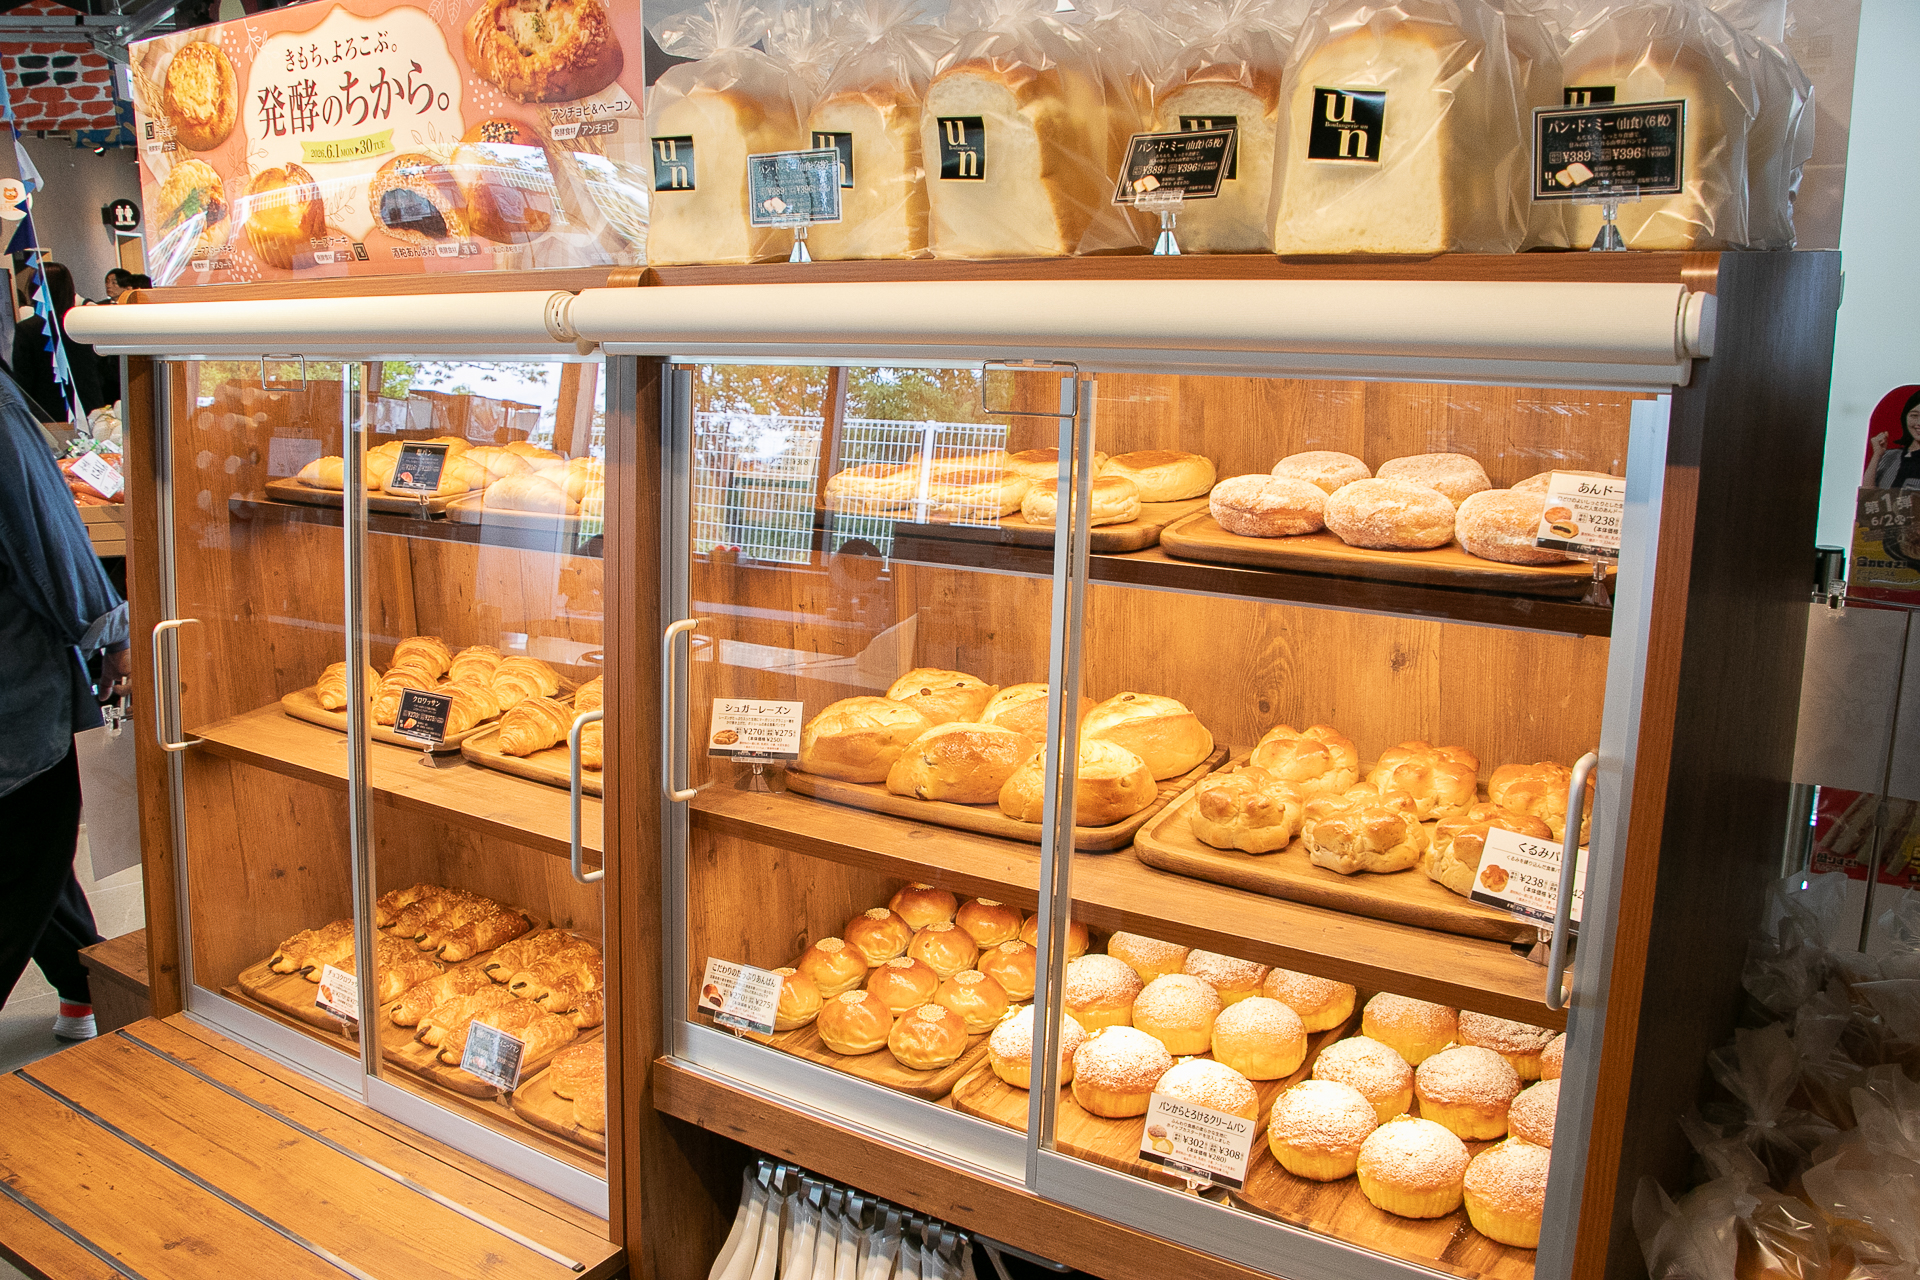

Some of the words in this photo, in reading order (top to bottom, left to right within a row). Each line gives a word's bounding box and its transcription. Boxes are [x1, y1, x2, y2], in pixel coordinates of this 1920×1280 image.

[285, 31, 398, 72] きもち、よろこぶ。
[257, 59, 450, 140] 発酵のちから。
[1323, 93, 1355, 122] u
[582, 122, 614, 135] アンチョビ
[943, 120, 968, 145] u
[1325, 121, 1359, 129] Boulangerie
[657, 140, 679, 162] u
[1338, 129, 1369, 158] n
[957, 150, 978, 176] n
[1562, 150, 1591, 163] ¥389
[1612, 147, 1642, 160] ¥396
[670, 165, 690, 188] n
[1143, 165, 1163, 175] ¥389
[1177, 162, 1198, 173] ¥396
[1589, 514, 1615, 526] ¥238
[412, 695, 441, 707] クロワッサン
[725, 703, 791, 715] シュガーレーズン
[743, 727, 762, 736] ¥270
[774, 729, 793, 737] ¥275
[1518, 842, 1562, 862] くるみパ
[1520, 873, 1544, 888] ¥238
[729, 990, 746, 1002] ¥270
[755, 998, 771, 1009] ¥275
[1158, 1101, 1247, 1133] パンからとろけるクリームパン
[1183, 1135, 1205, 1149] ¥302
[1219, 1145, 1241, 1160] ¥308
[1208, 1152, 1227, 1164] ¥280)
